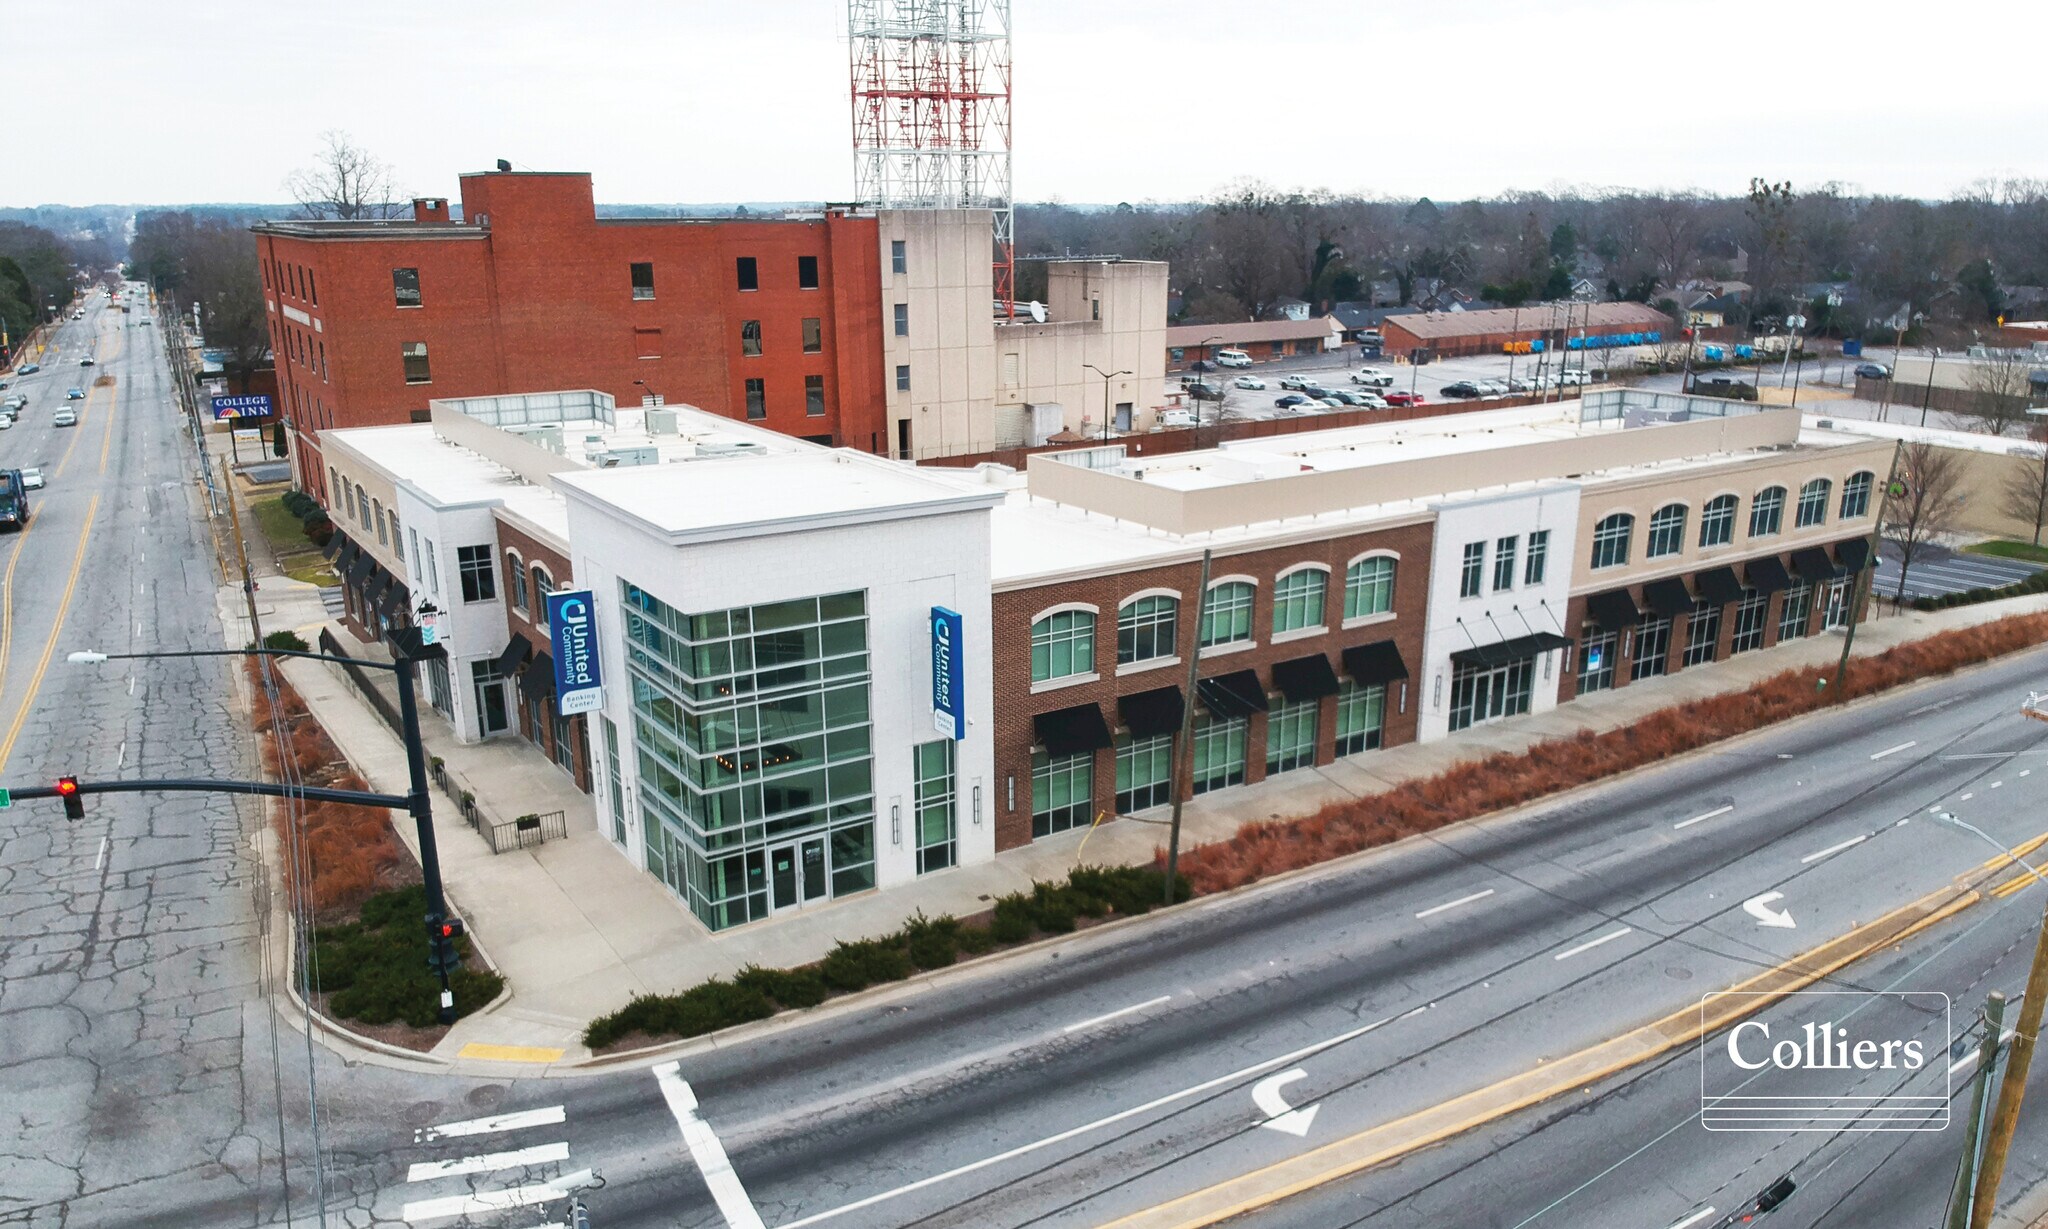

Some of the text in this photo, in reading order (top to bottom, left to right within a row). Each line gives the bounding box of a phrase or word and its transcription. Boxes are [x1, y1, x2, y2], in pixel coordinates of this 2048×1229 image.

[215, 396, 268, 407] COLLEGE
[241, 406, 269, 417] INN
[561, 626, 576, 685] Community
[572, 624, 593, 685] United
[939, 646, 951, 708] United
[566, 692, 596, 704] Banking
[569, 700, 595, 709] Center
